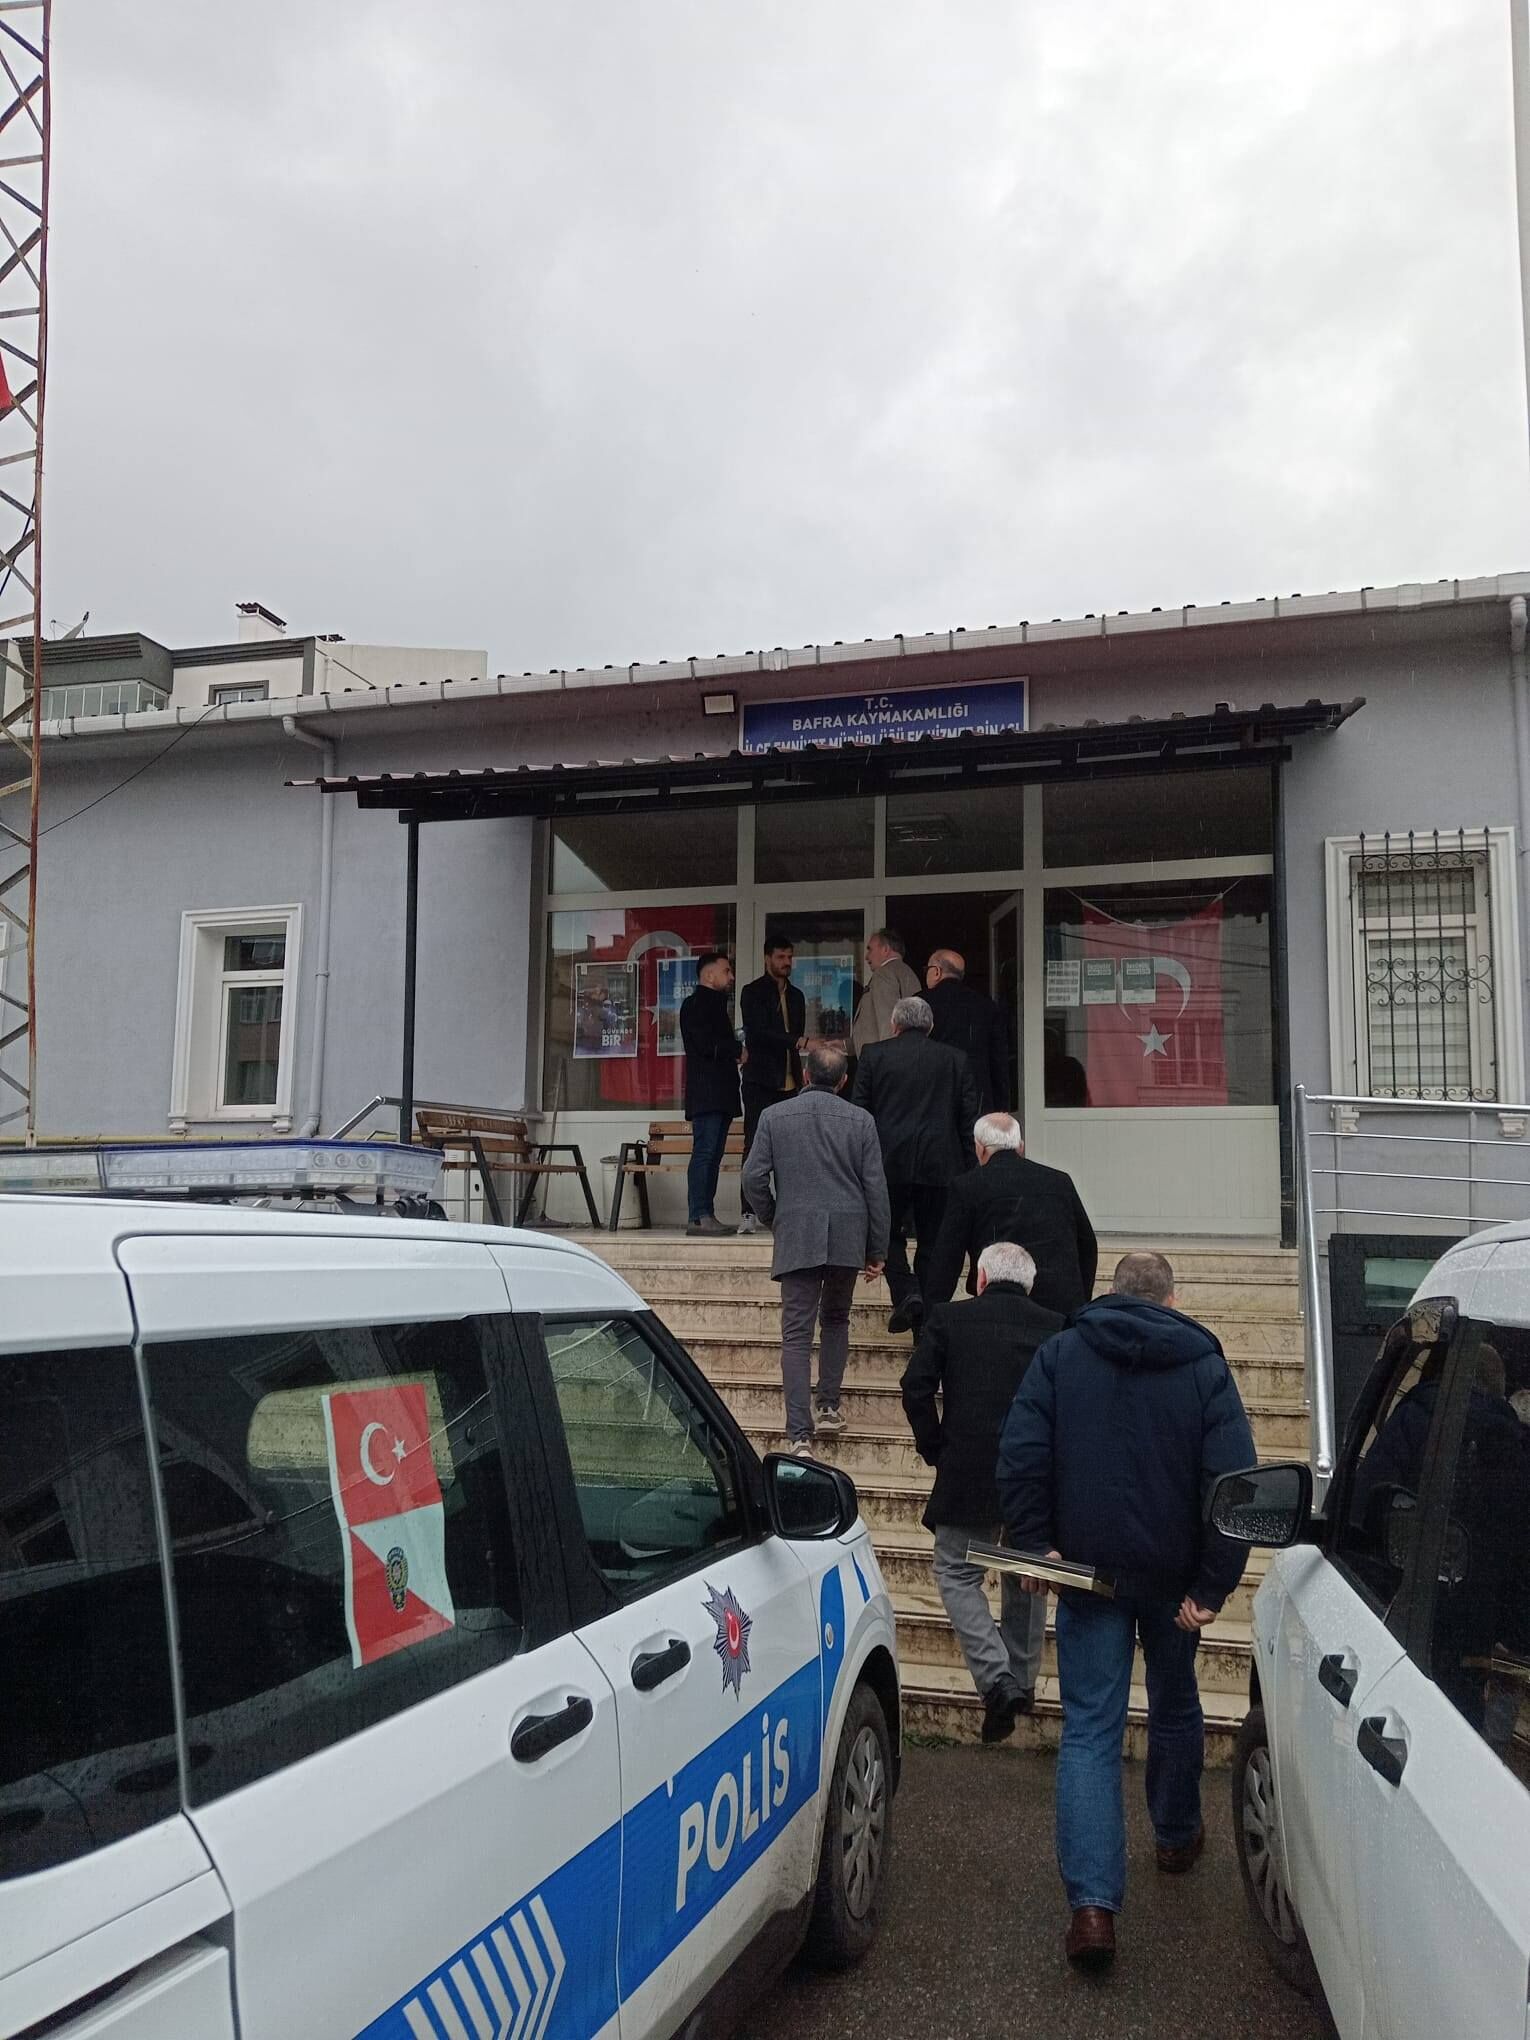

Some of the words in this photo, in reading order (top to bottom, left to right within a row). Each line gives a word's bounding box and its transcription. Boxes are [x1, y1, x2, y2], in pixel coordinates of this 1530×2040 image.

[864, 697, 893, 710] T.C.
[792, 714, 841, 731] BAFRA
[847, 702, 969, 727] KAYMAKAMLIĞI
[602, 1034, 621, 1047] BİR
[675, 1712, 790, 1914] POLİS
